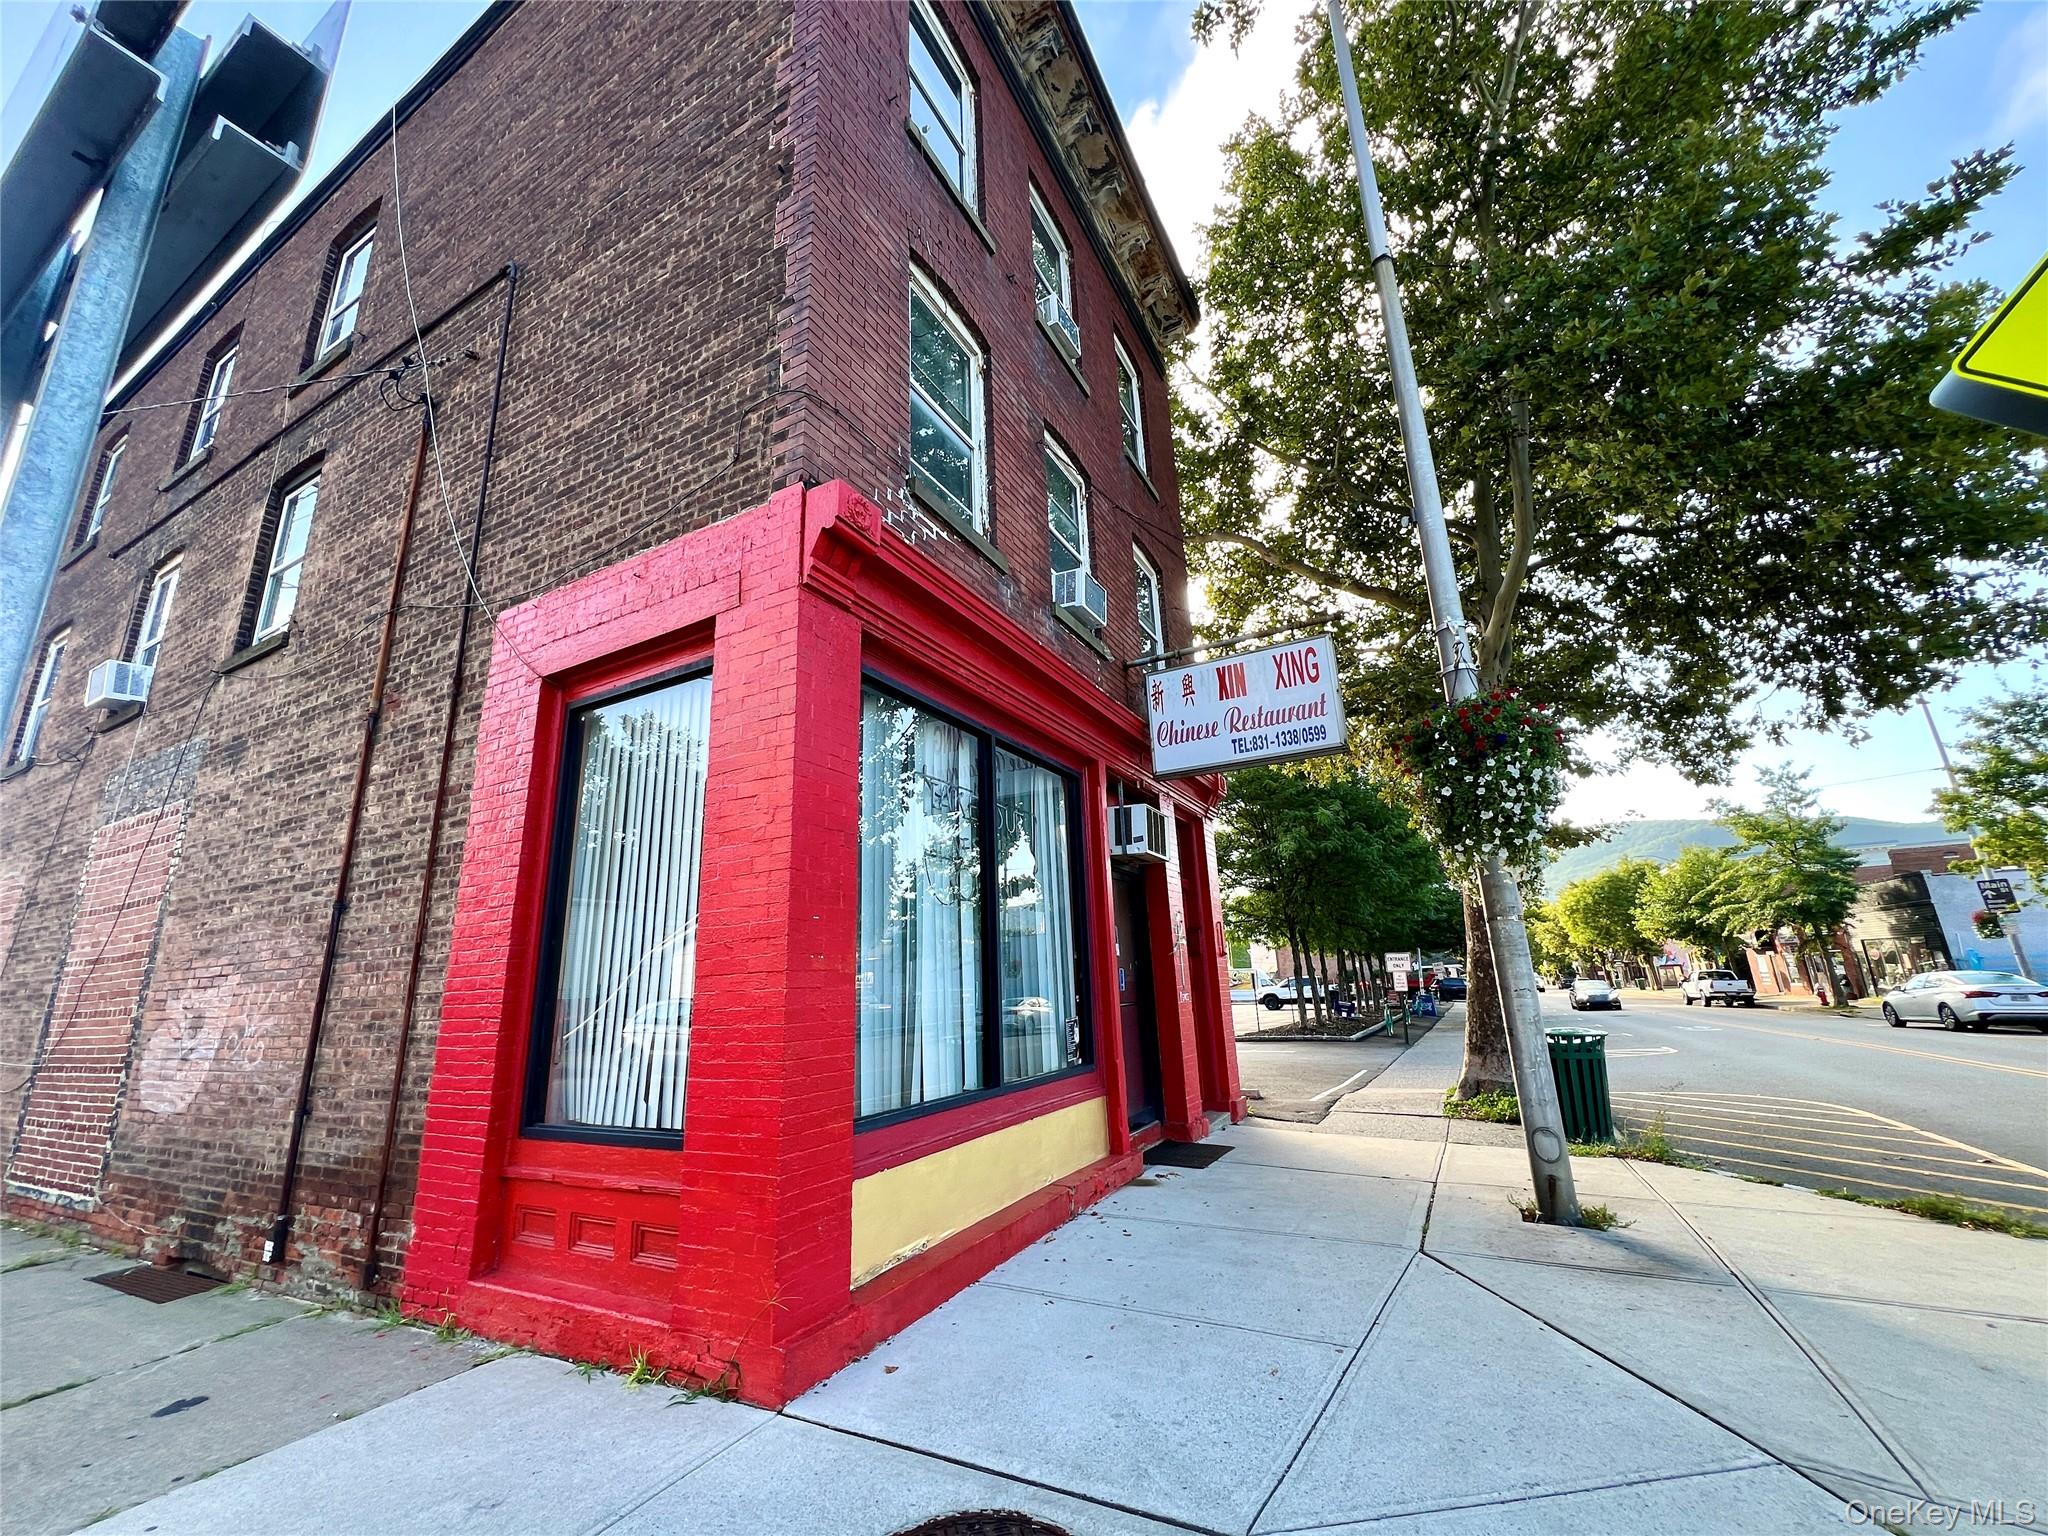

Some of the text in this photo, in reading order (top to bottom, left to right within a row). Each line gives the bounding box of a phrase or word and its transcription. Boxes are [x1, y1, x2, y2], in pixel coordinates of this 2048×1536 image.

[1216, 646, 1320, 701] XIN XING
[1156, 693, 1328, 748] Chinese Restaurant
[1978, 881, 2008, 890] Main
